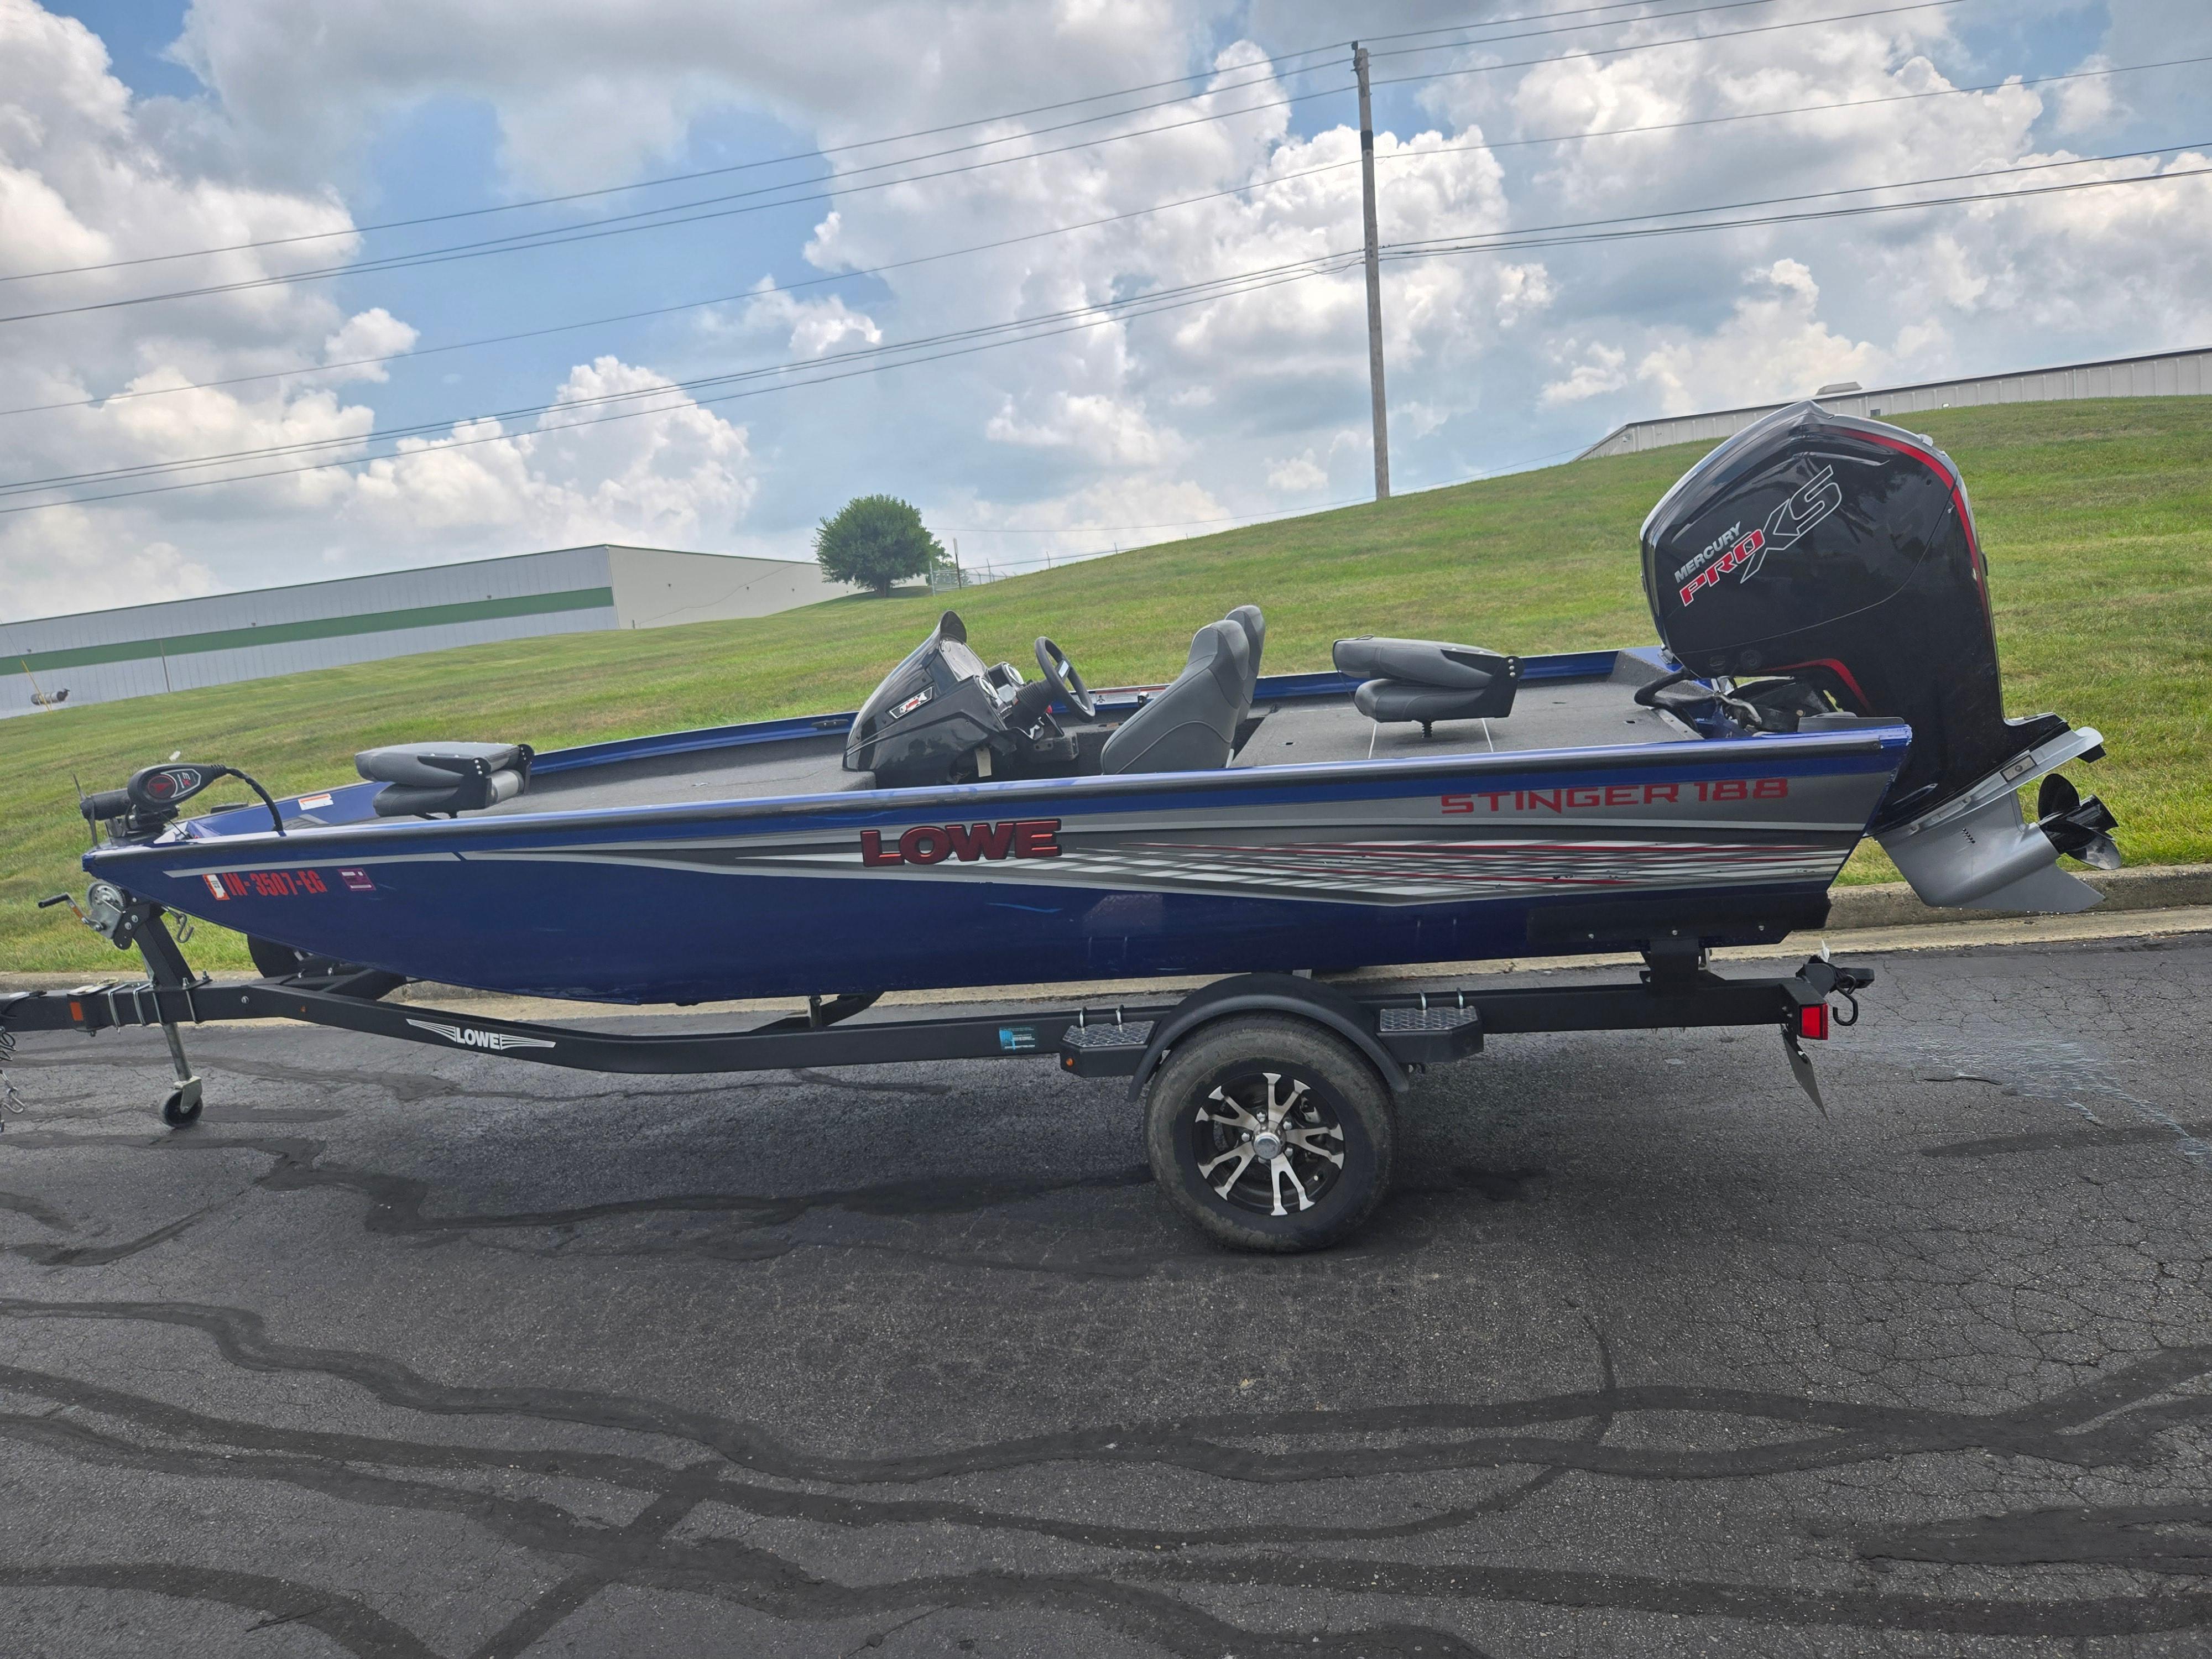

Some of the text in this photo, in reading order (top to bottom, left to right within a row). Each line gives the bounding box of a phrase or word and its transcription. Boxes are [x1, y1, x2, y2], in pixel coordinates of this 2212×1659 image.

[1674, 521, 1741, 583] MERCURY
[1679, 529, 1766, 607] PRO
[1441, 778, 1788, 814] STINGER 188
[860, 818, 1062, 867] LOWE
[456, 1027, 500, 1050] LOWE
